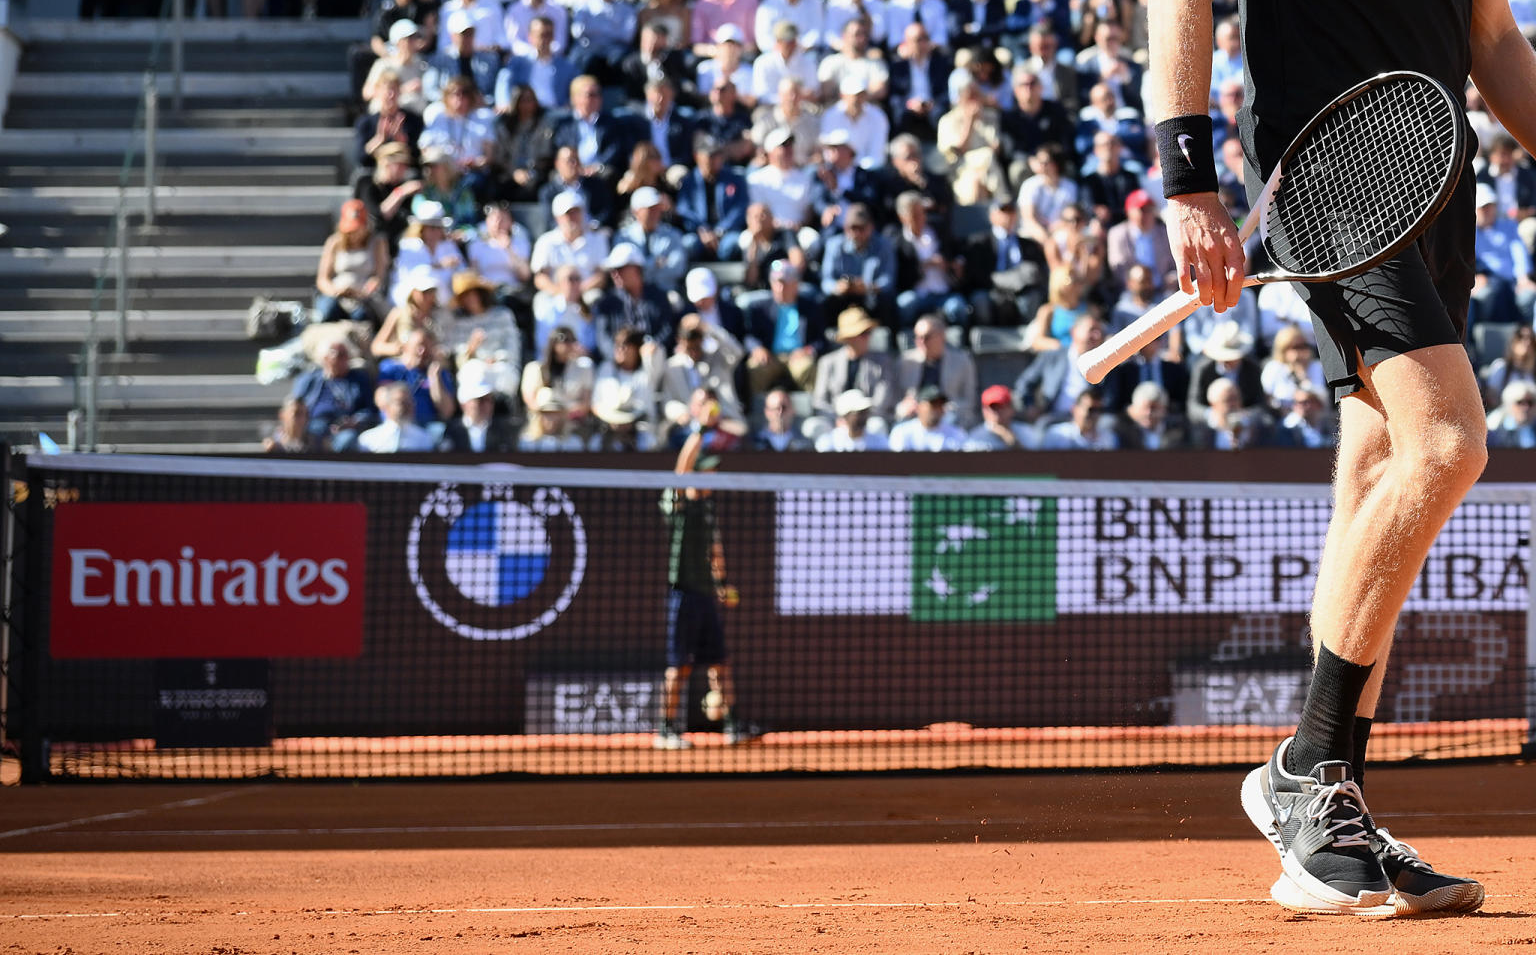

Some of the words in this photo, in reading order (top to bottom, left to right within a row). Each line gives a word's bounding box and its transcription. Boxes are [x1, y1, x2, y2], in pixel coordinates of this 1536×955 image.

[1096, 498, 1236, 541] BNL
[68, 545, 350, 606] Emirates
[1096, 553, 1243, 603] BNP
[554, 682, 652, 722] EA7
[1206, 675, 1300, 714] EA7
